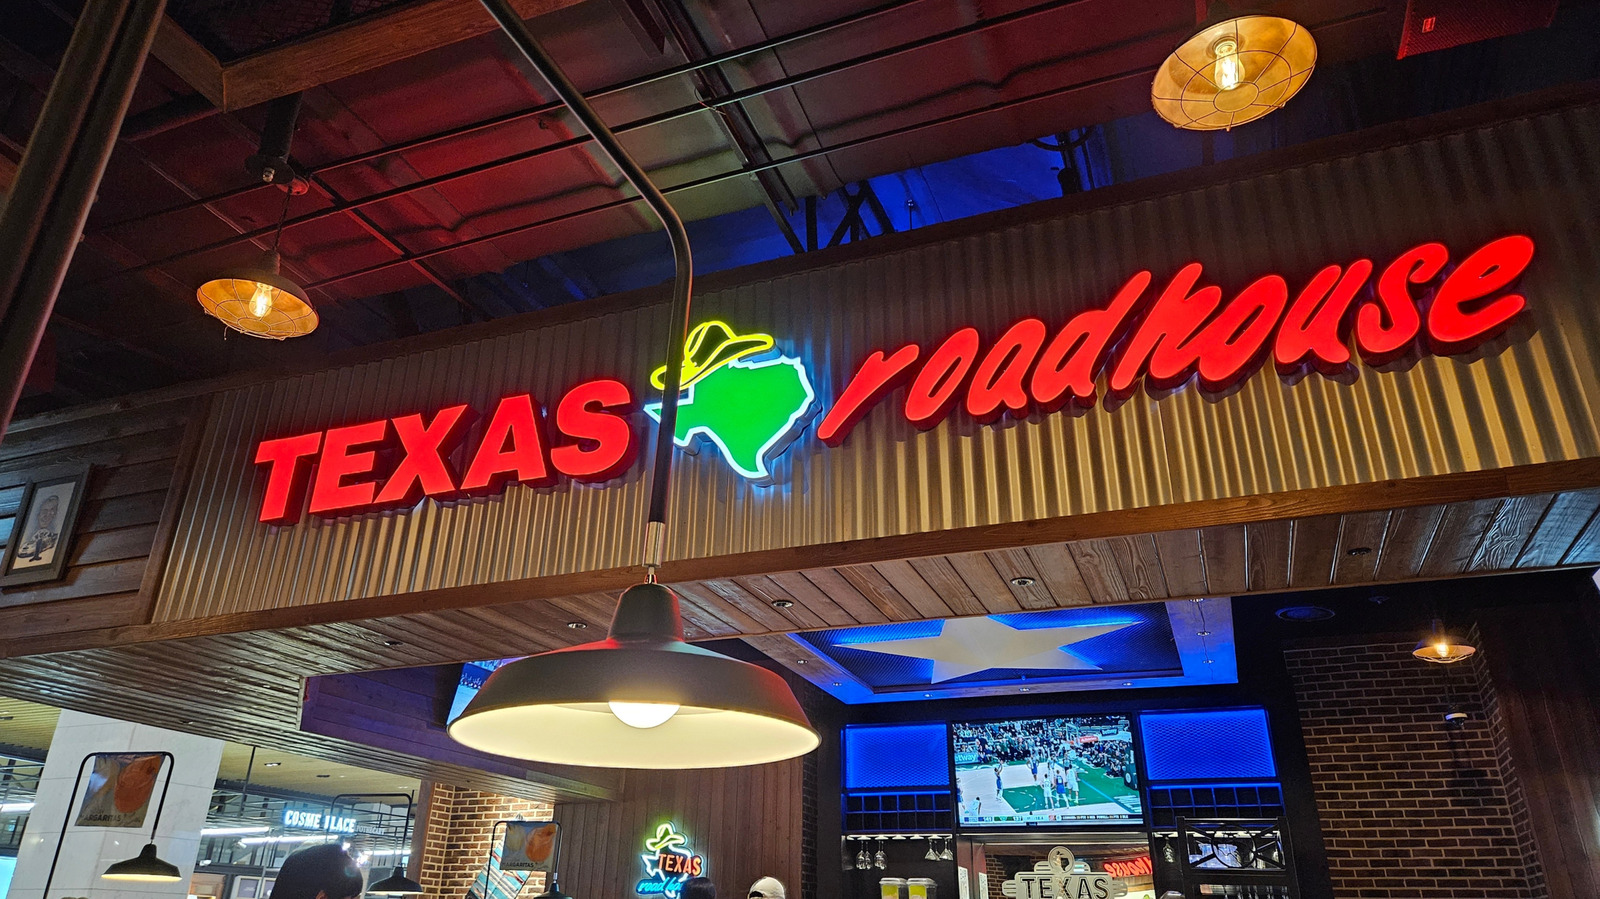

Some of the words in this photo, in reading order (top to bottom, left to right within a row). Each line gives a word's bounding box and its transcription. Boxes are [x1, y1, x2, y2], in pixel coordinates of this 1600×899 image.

[254, 379, 631, 522] TEXAS
[284, 809, 321, 829] COSME
[658, 853, 701, 877] TEXAS
[1020, 878, 1108, 899] TEXAS
